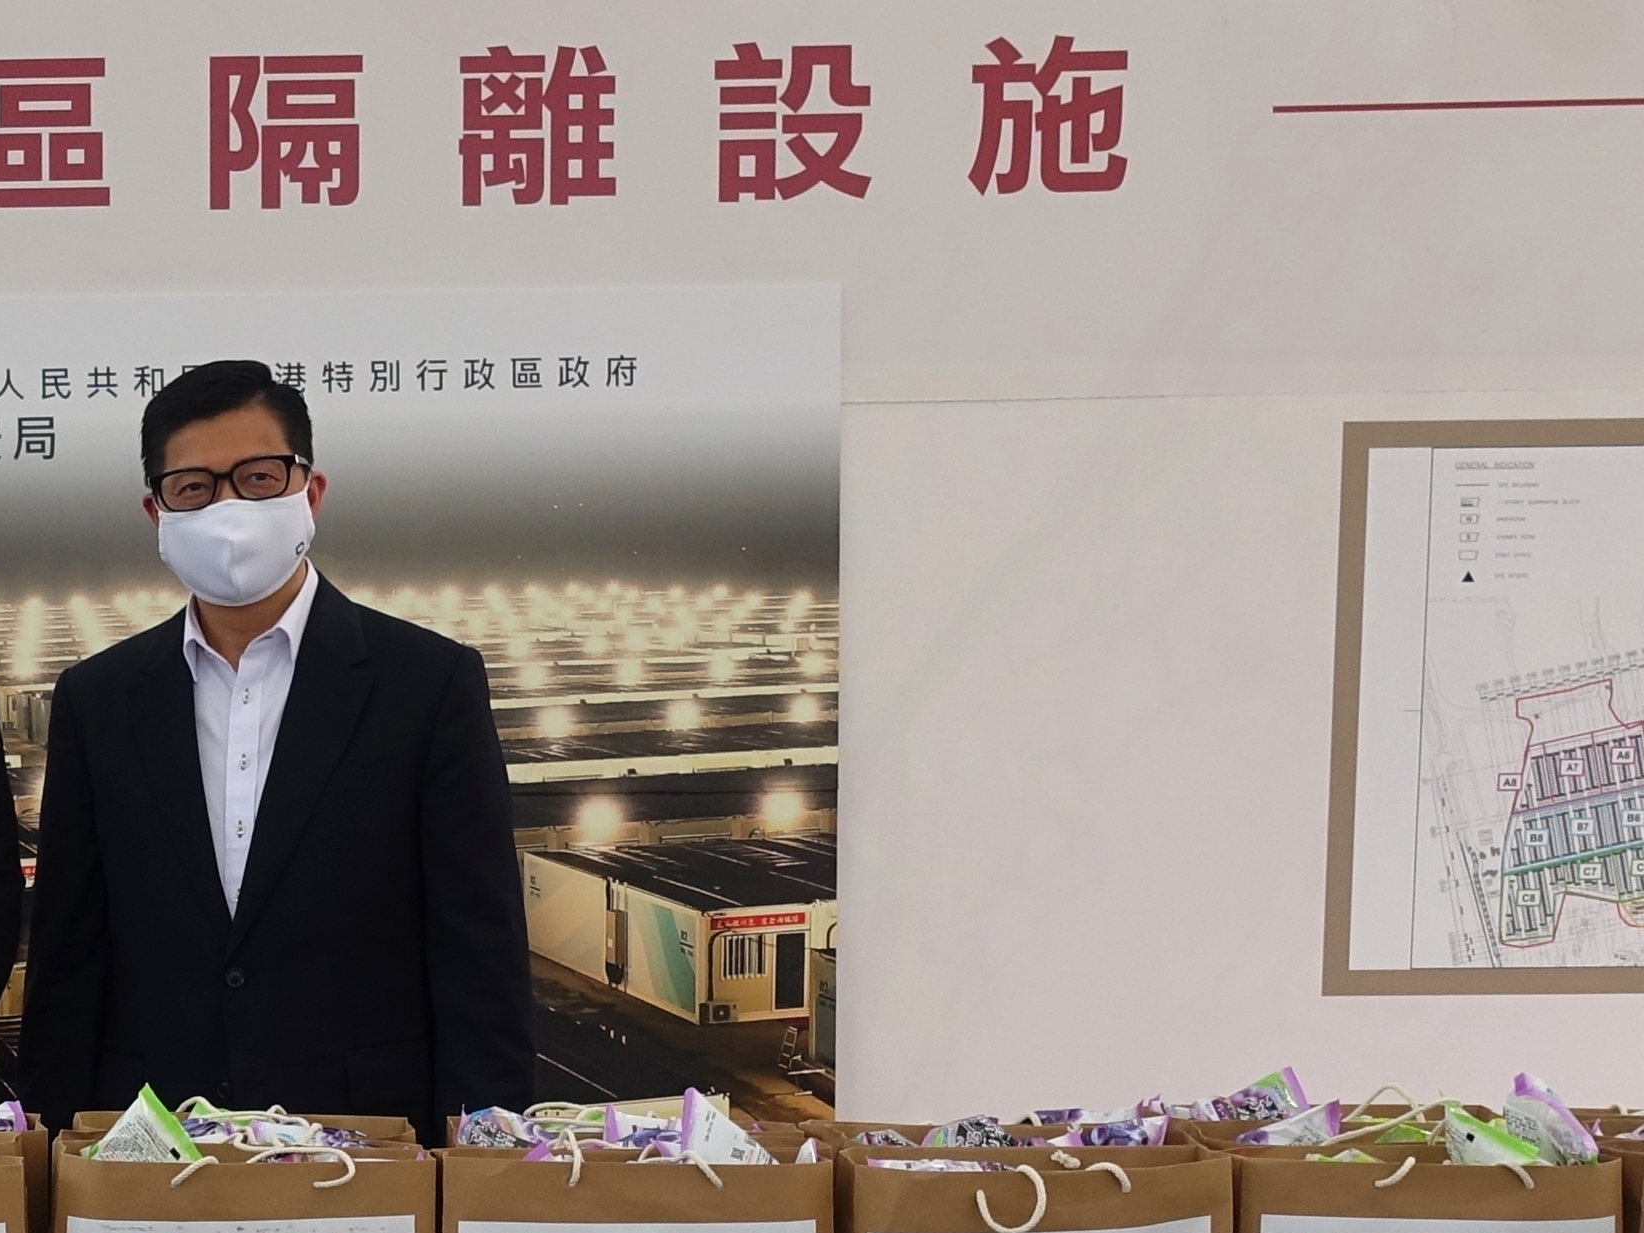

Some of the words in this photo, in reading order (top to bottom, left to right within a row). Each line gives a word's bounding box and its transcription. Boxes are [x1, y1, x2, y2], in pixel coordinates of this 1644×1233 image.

[1616, 751, 1630, 760] A6
[1566, 763, 1579, 772] A7
[1503, 777, 1517, 787] A8
[1627, 813, 1641, 822] B6
[1577, 822, 1590, 831] B7
[1583, 866, 1597, 876] C7
[1522, 893, 1535, 903] C8
